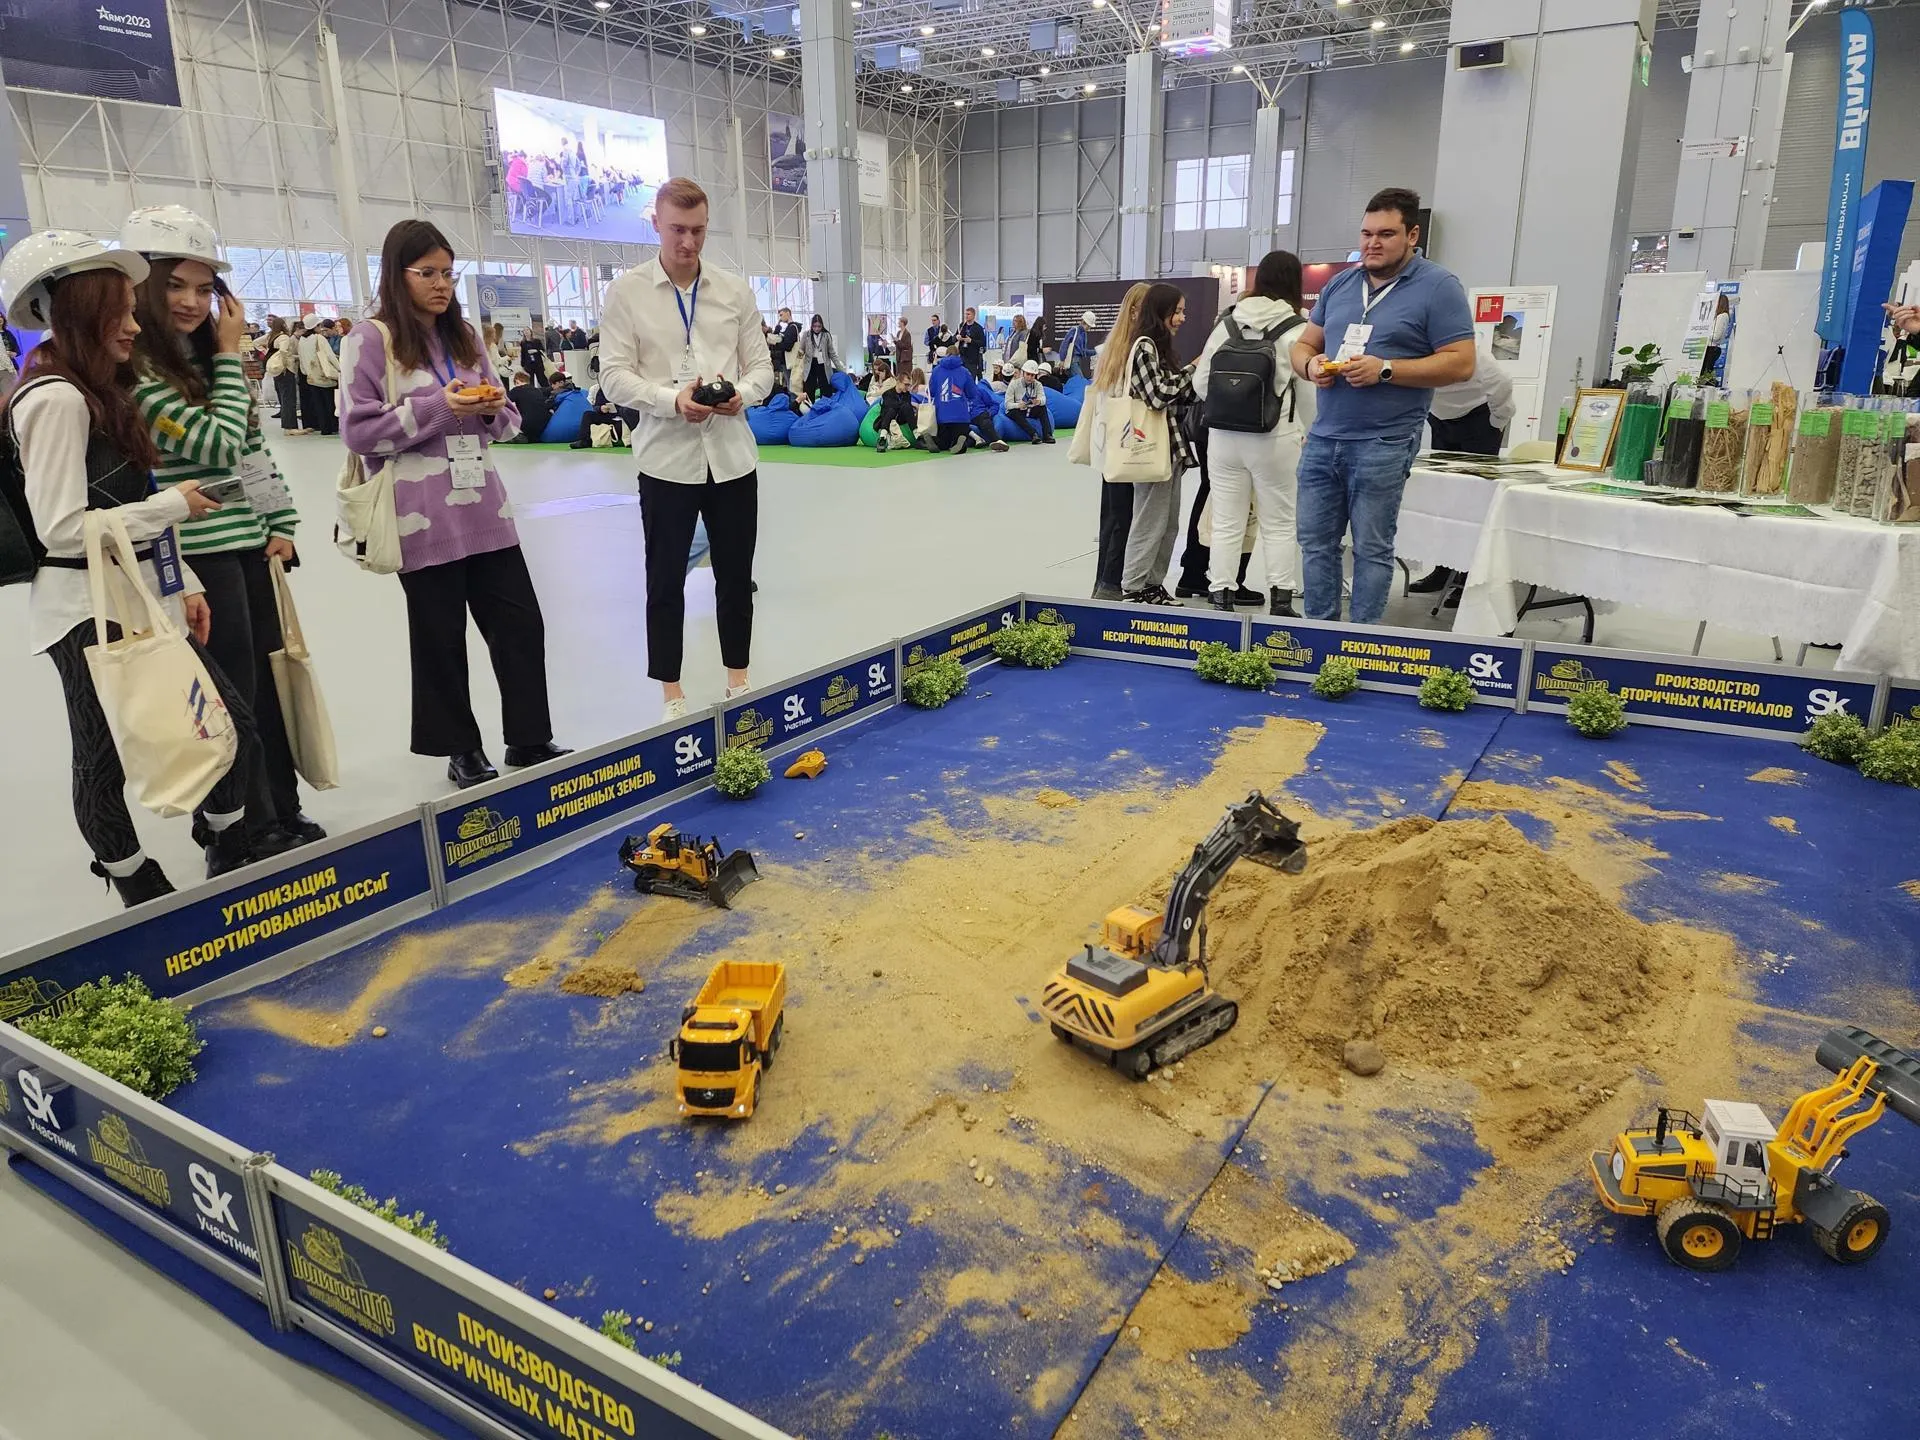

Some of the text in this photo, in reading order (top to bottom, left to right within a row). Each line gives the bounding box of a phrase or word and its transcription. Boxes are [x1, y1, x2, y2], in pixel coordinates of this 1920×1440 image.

[98, 25, 152, 39] GENERAL SPONSOR
[1102, 630, 1188, 650] НЕСОРТИРОВАННЫХ
[1130, 619, 1188, 635] УТИЛИЗАЦИЯ
[1341, 640, 1431, 661] РЕКУЛЬТИВАЦИЯ
[1468, 652, 1504, 679] Sk
[868, 662, 887, 687] Sk
[1655, 673, 1760, 697] ПРОИЗВОДСТВО
[783, 693, 806, 722] Sk
[1620, 687, 1794, 719] ВТОРИЧНЫХ МАТЕРИАЛОВ
[1806, 688, 1851, 717] Sk
[674, 734, 704, 765] Sk
[549, 754, 641, 802] РЕКУЛЬТИВАЦИЯ
[676, 757, 713, 777] Участник
[536, 769, 656, 829] НАРУШЕННЫХ ЗЕМЕЛЬ
[221, 867, 337, 926] УТИЛИЗАЦИЯ
[165, 871, 391, 977] НЕСОРТИРОВАННЫХ ОССиГ
[18, 1069, 61, 1130] Sk
[27, 1115, 78, 1156] Участник
[188, 1162, 240, 1233] Sk
[196, 1213, 260, 1262] Участник
[412, 1322, 543, 1422] ВТОРИЧНЫХ
[457, 1311, 636, 1437] ПРОИЗВОДСТВО
